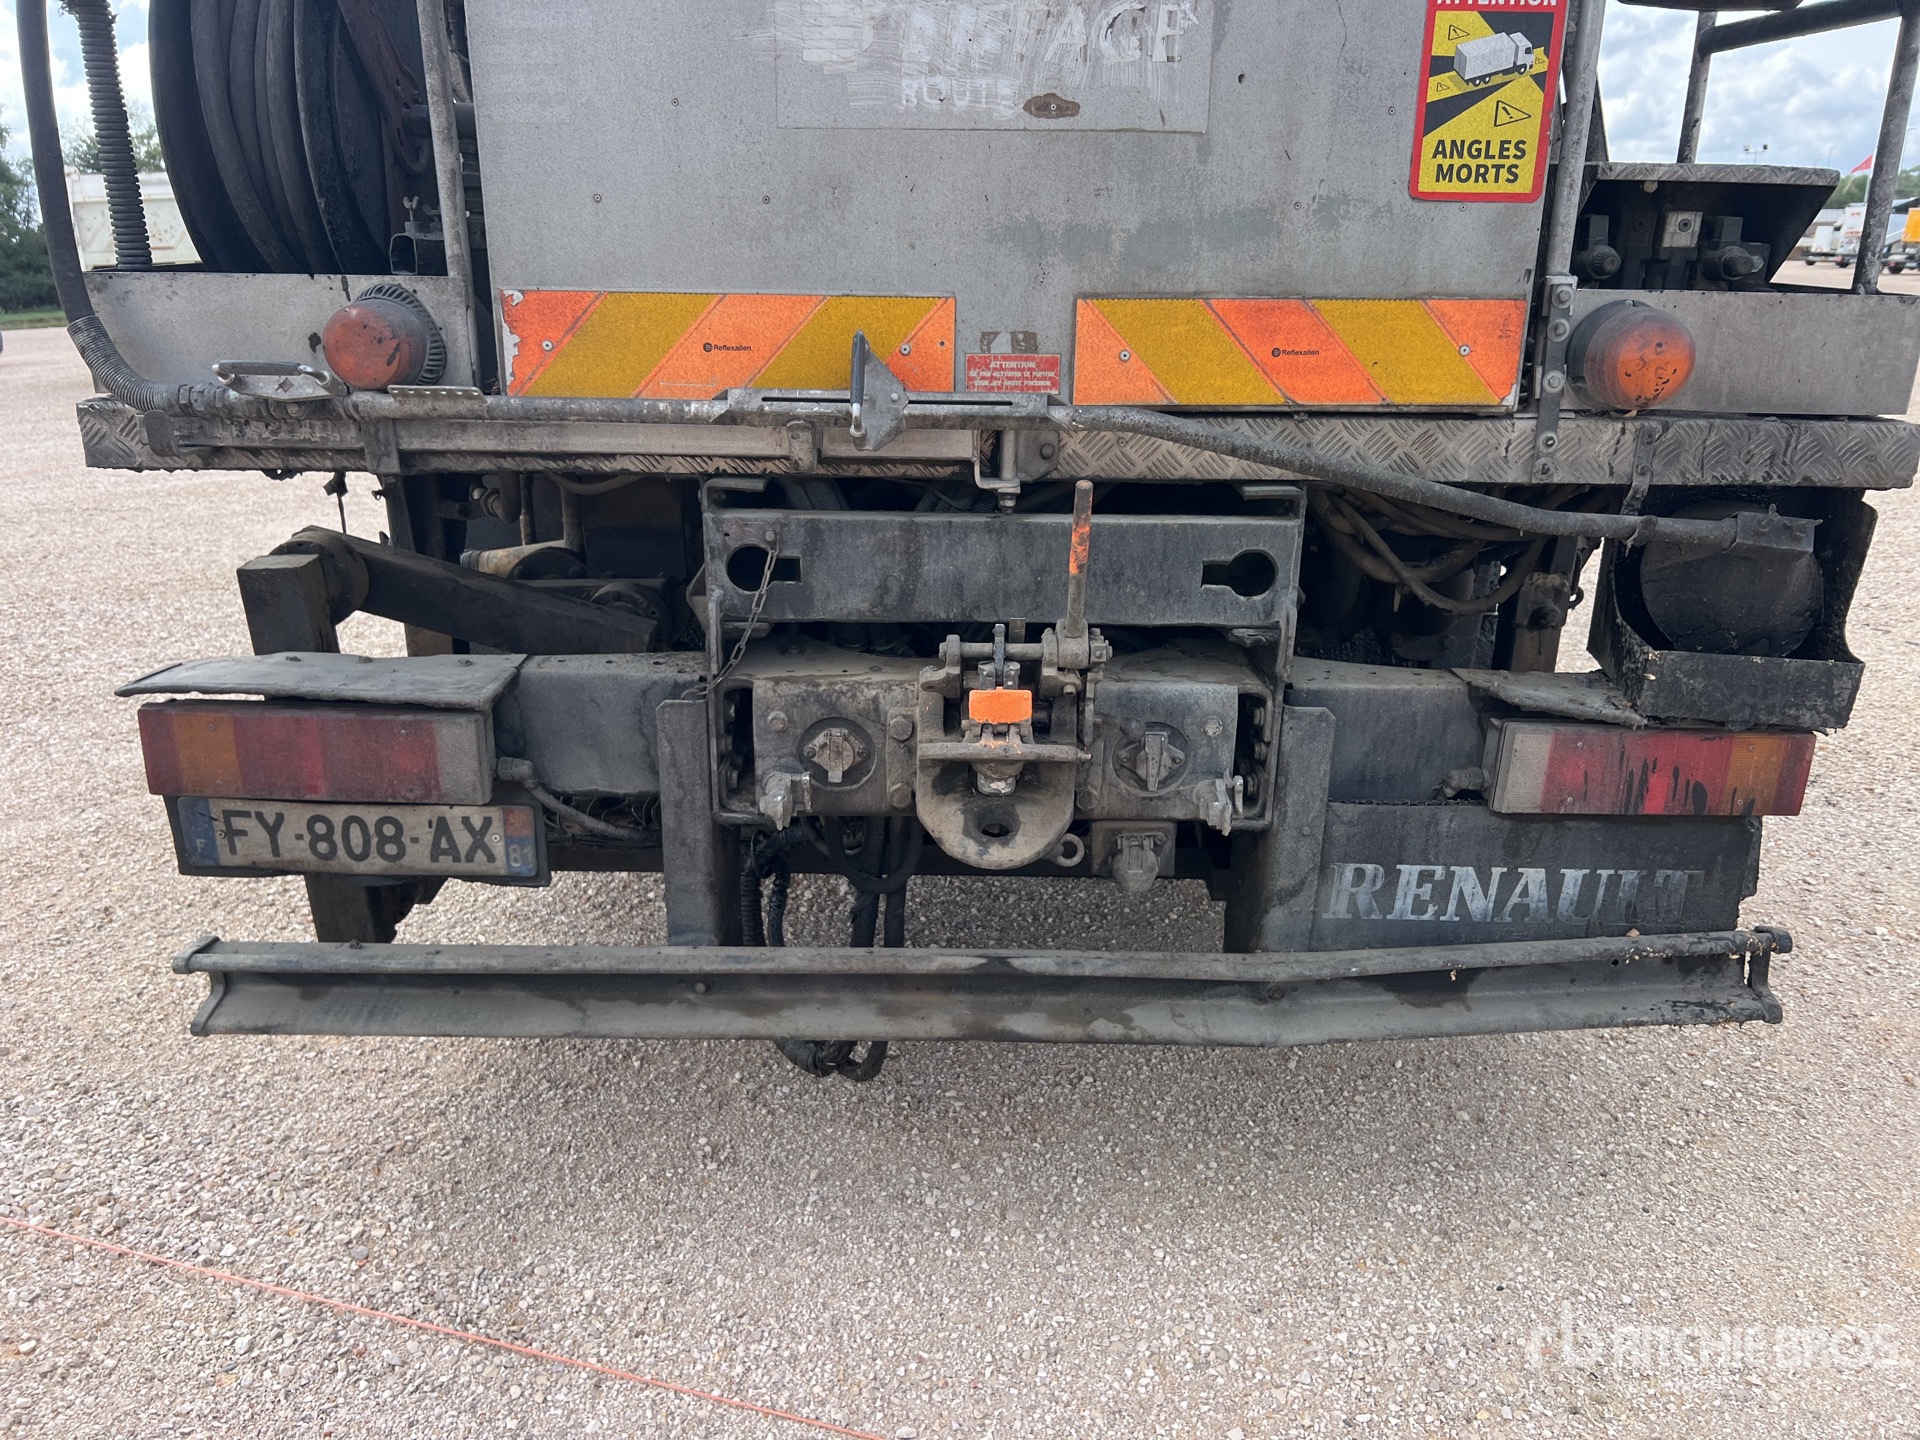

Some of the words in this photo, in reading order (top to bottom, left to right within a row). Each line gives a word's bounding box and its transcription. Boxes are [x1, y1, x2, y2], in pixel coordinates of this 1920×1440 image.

[1432, 139, 1527, 160] ANGLES
[1435, 163, 1519, 184] MORTS
[713, 344, 752, 352] Reflexallen
[222, 809, 497, 864] FY-808-AX
[1322, 862, 1706, 927] RENAULT
